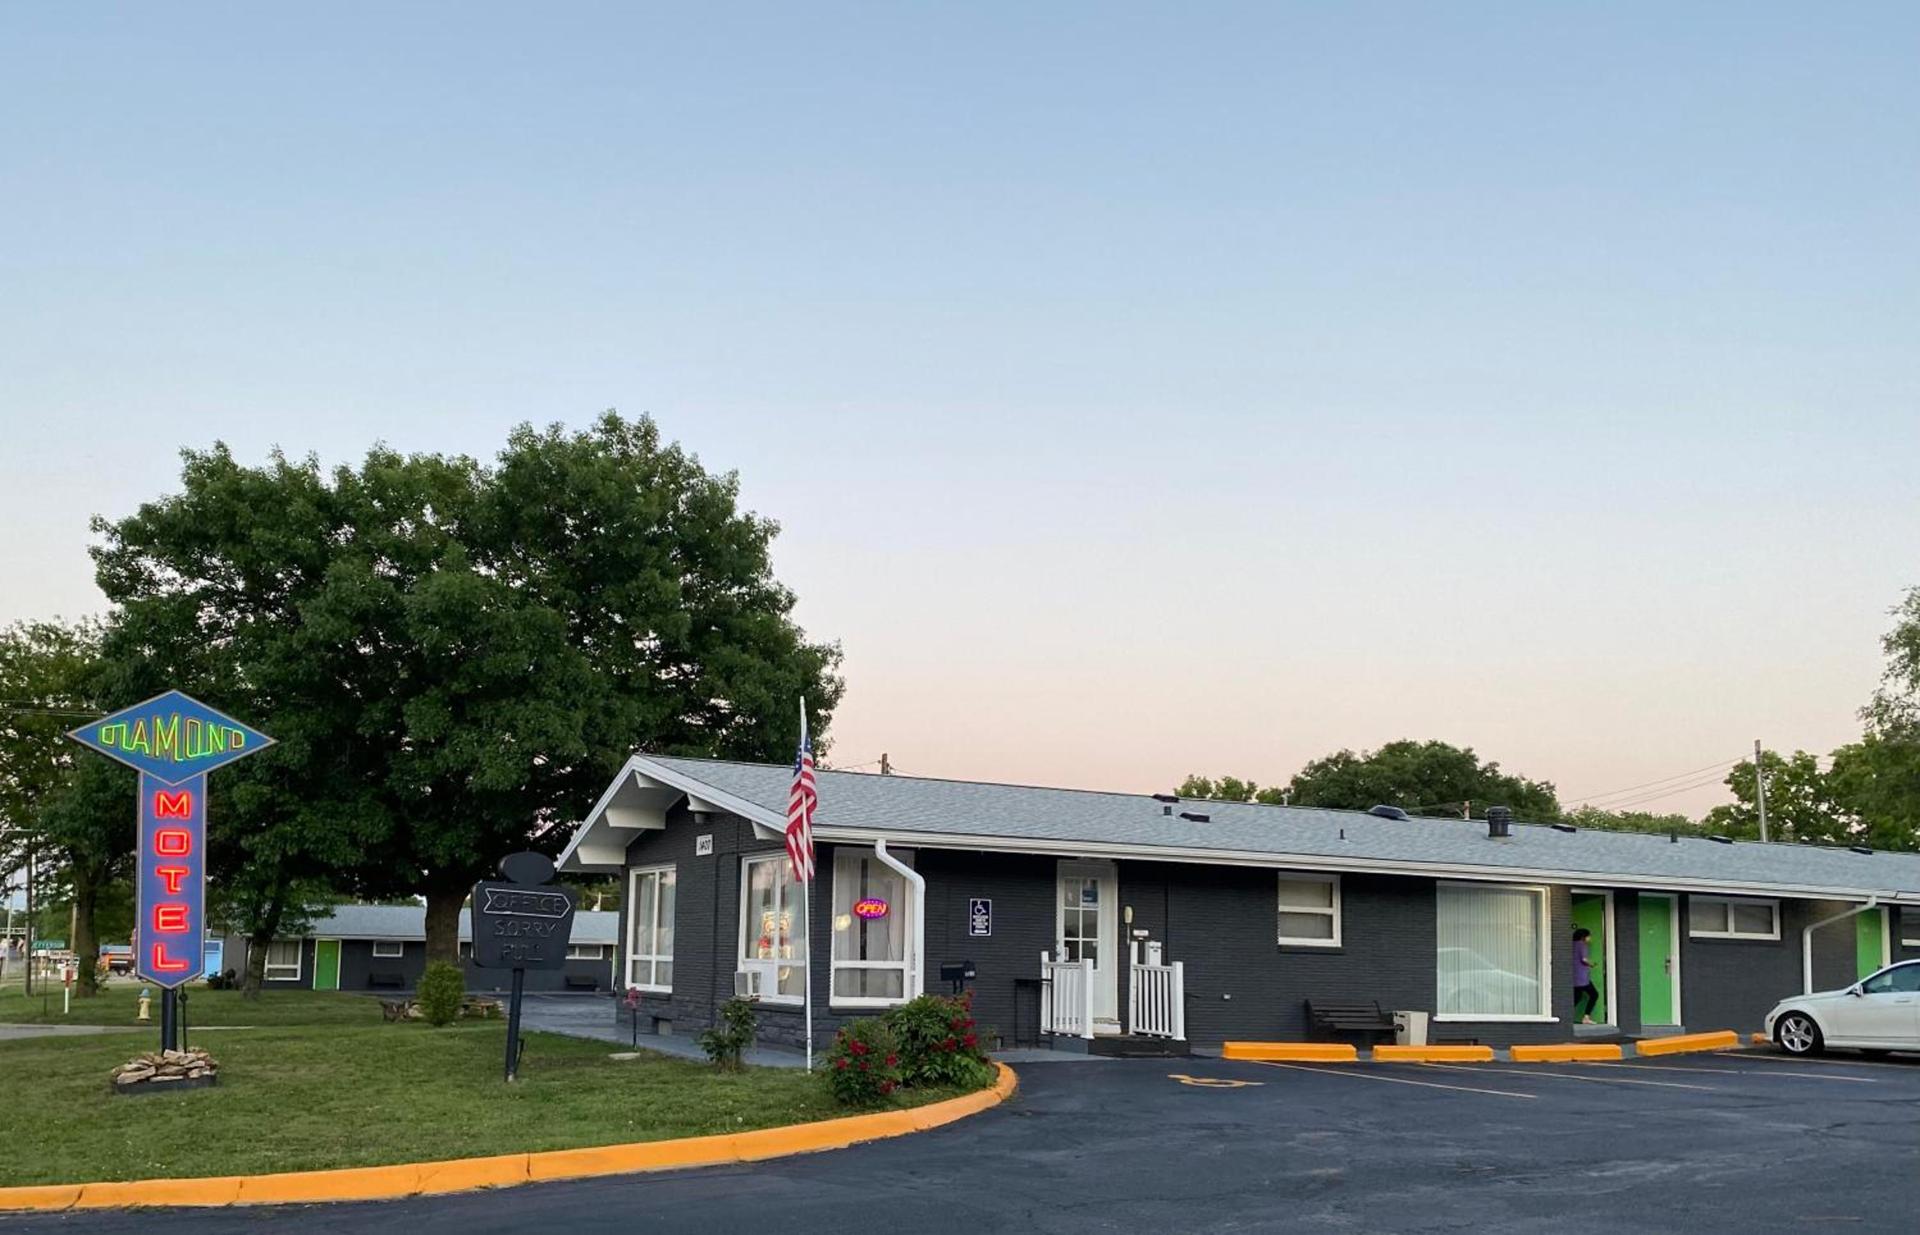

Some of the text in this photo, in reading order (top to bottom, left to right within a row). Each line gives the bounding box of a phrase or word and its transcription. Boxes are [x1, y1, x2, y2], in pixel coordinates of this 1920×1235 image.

[154, 789, 190, 970] MOTEL
[493, 893, 562, 913] OFFICE
[856, 902, 888, 915] OPEN
[494, 919, 558, 938] SORRY
